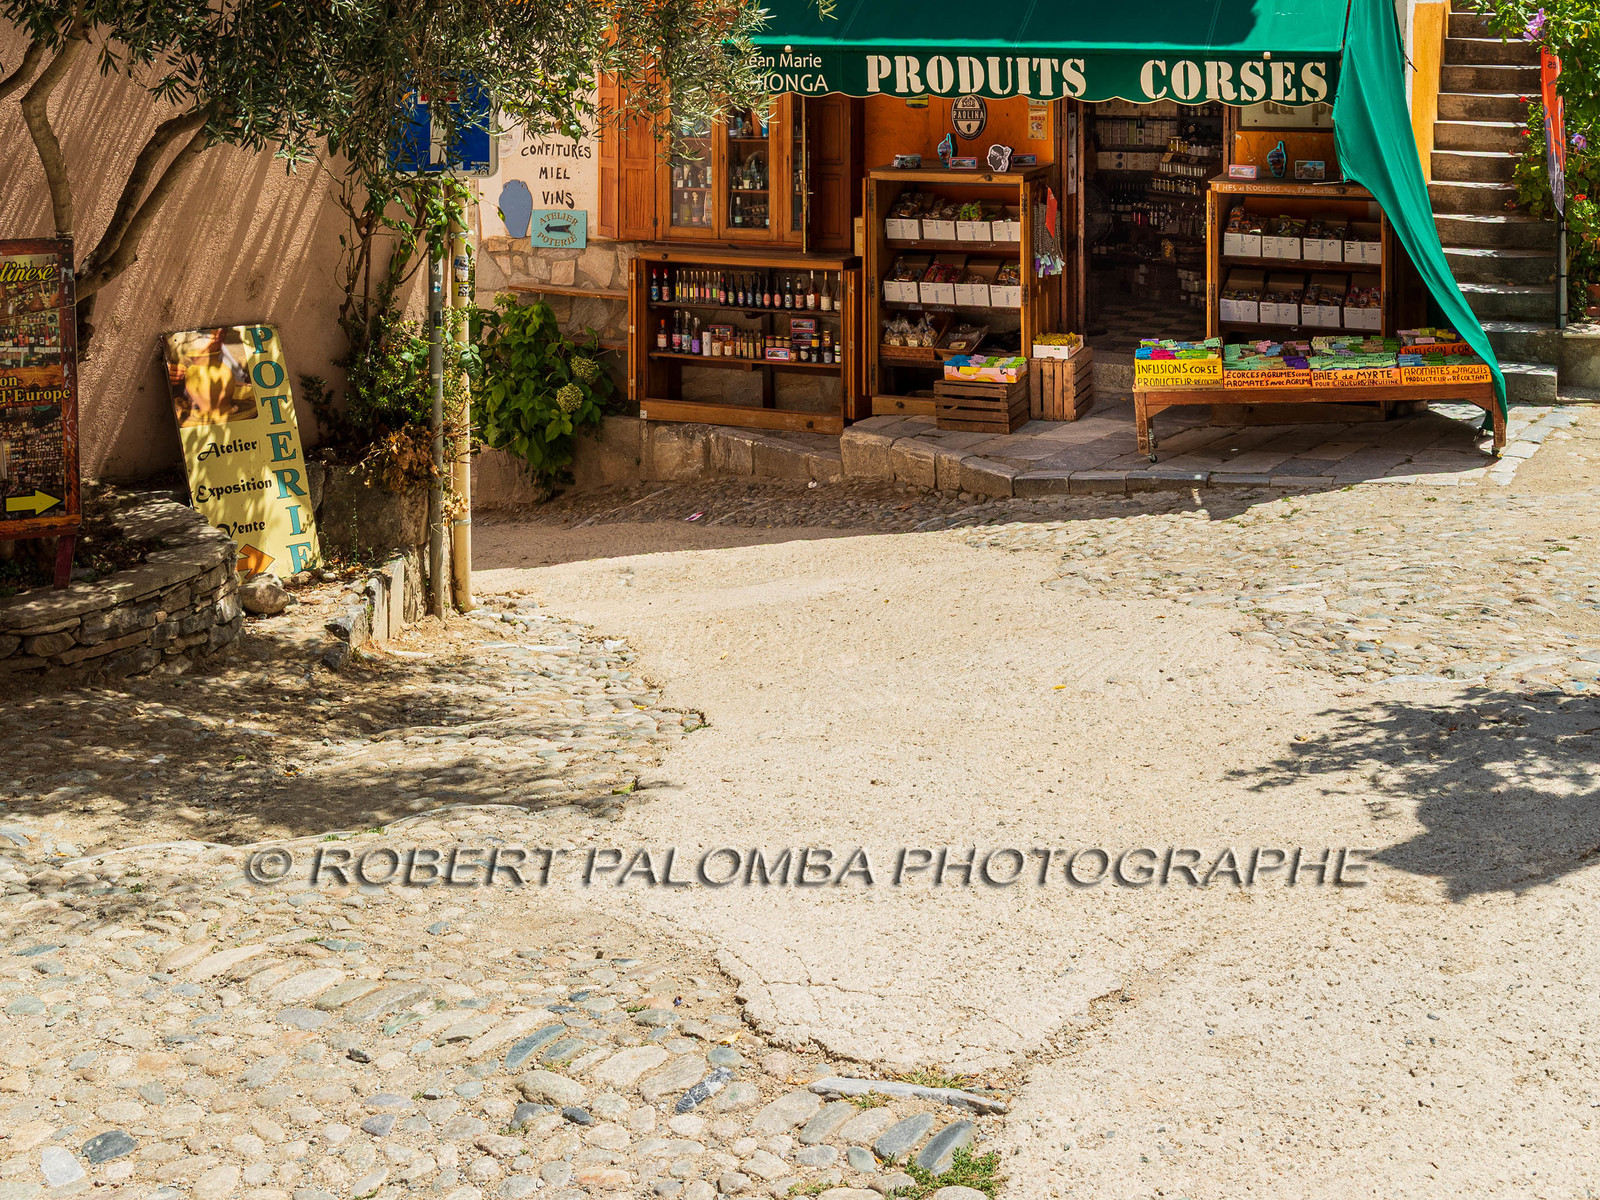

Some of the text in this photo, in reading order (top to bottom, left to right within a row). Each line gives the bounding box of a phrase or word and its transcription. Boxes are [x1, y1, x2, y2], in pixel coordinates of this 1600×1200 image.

[779, 53, 822, 68] Marie
[866, 55, 1328, 102] PRODUITS CORSES
[953, 110, 985, 119] PAOLINA
[521, 142, 592, 160] CONFITURES
[539, 166, 571, 180] MIEL
[541, 189, 575, 209] VINS
[539, 212, 579, 227] ATELIER
[536, 231, 578, 247] POTERIE
[1137, 361, 1218, 375] INFUSIONS CORSE
[1356, 369, 1393, 380] MYRTE
[1403, 366, 1450, 377] AROMATES
[1452, 374, 1489, 382] RÉCOLTANT
[197, 438, 257, 462] Atelier
[247, 326, 316, 575] POTERIE
[196, 477, 272, 504] Exposition
[216, 521, 266, 539] Vente
